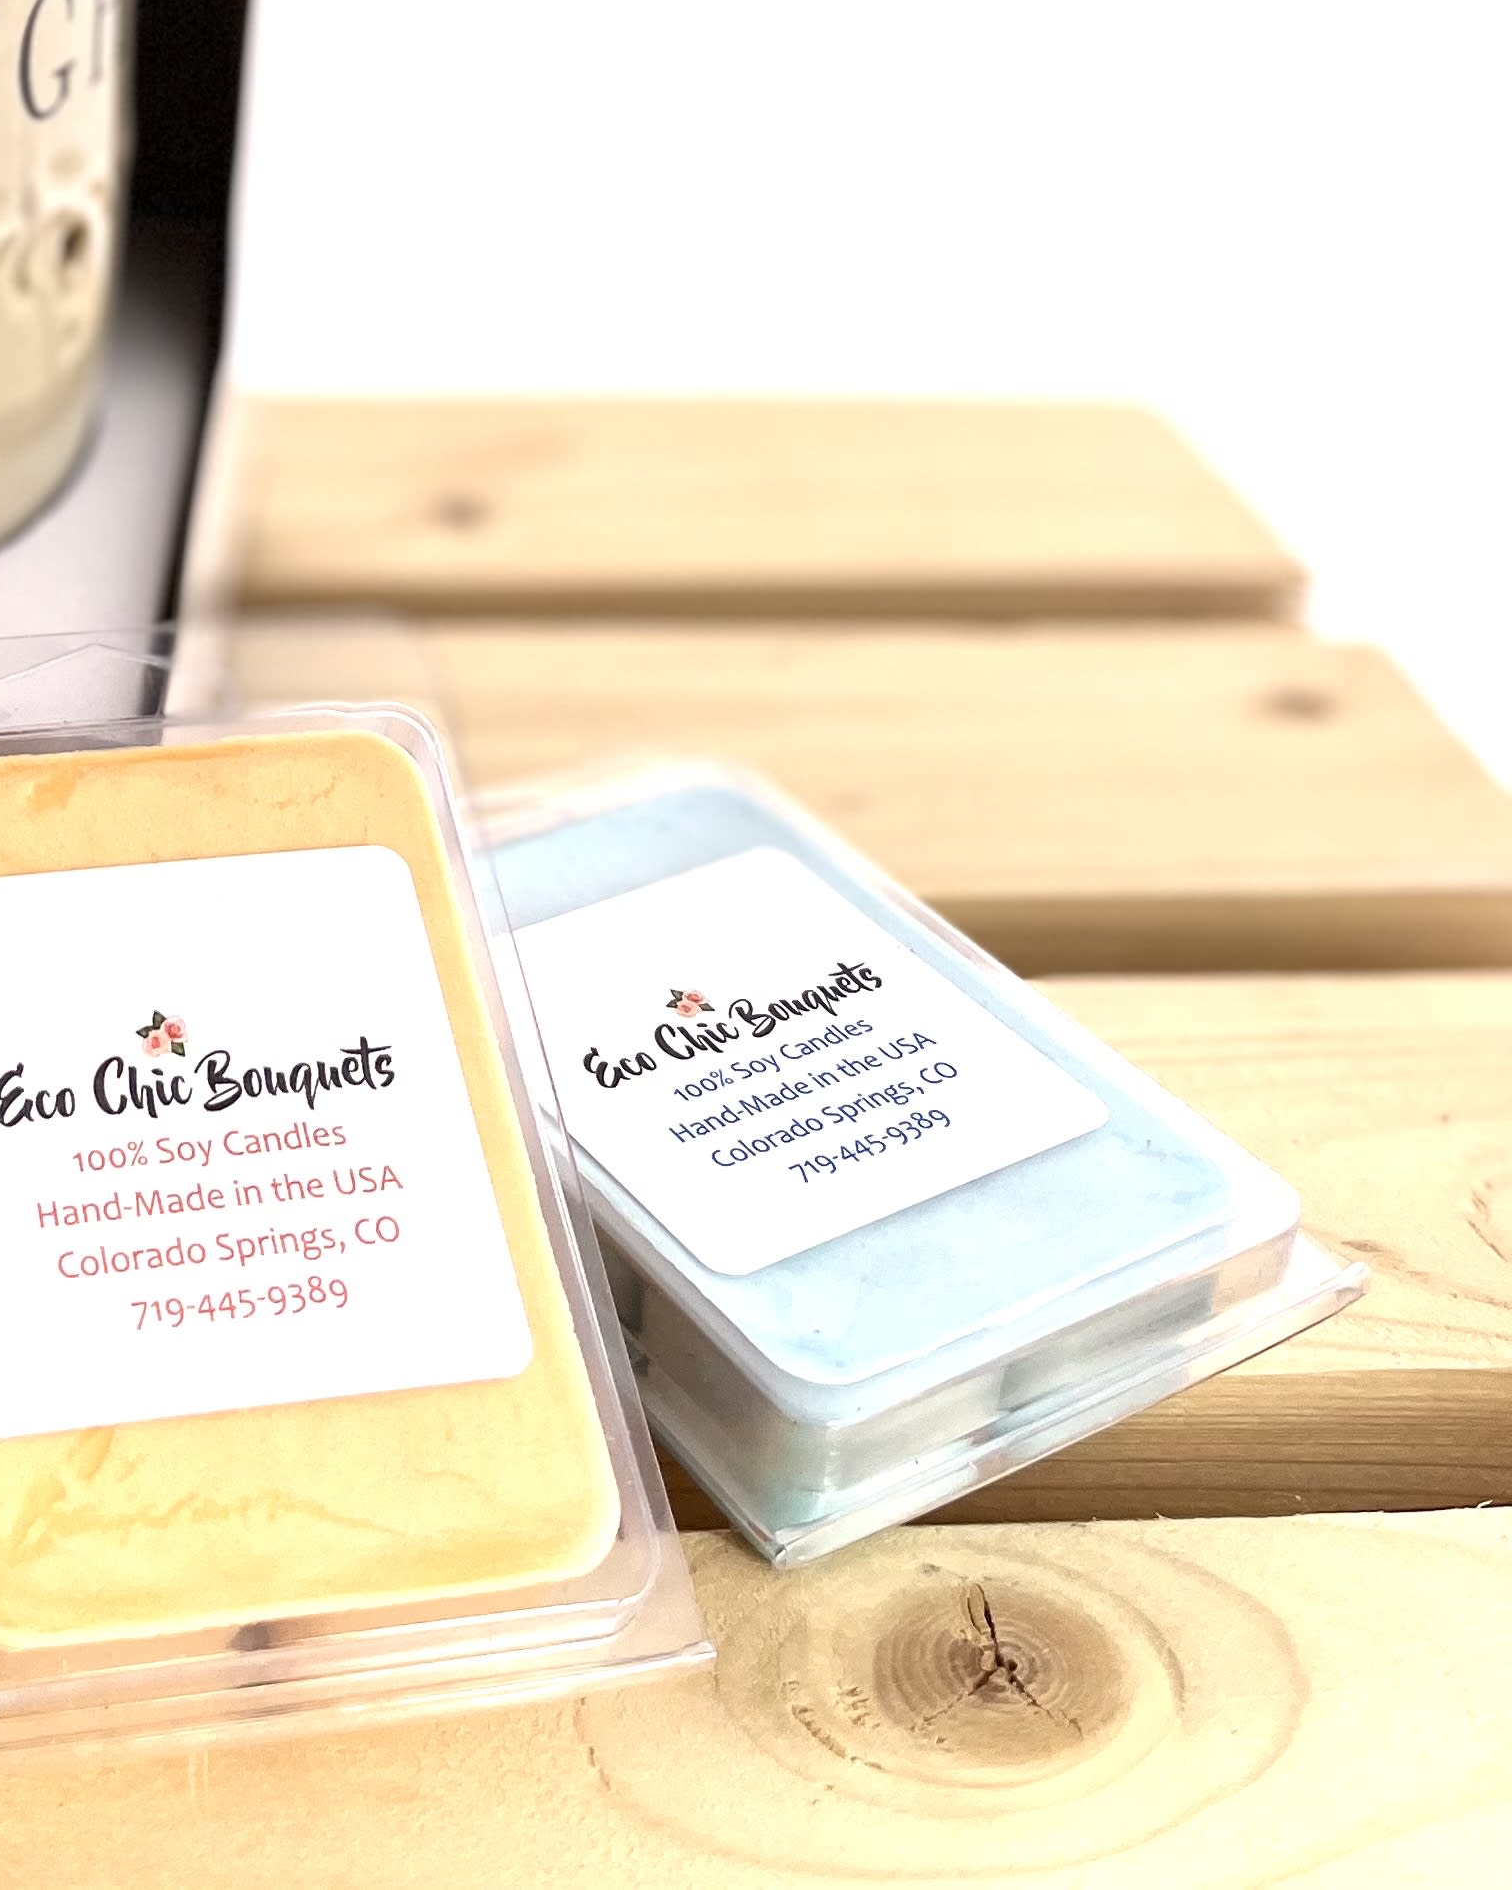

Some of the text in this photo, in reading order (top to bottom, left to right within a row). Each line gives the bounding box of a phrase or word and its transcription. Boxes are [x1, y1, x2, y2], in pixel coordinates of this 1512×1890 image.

[583, 962, 883, 1089] Eco Chic Bouquets
[673, 1018, 874, 1102] 100% Soy Candles
[93, 1057, 193, 1118] Chic
[194, 1036, 395, 1112] Bouquets
[669, 1031, 937, 1143] Hand-Made in the USA
[711, 1061, 958, 1168] Colorado Springs, CO
[72, 1121, 347, 1173] 100% Soy Candles
[788, 1109, 951, 1183] 719-445-9389
[37, 1164, 403, 1229] Hand-Made in the USA
[57, 1216, 400, 1279] Colorado Springs, CO
[131, 1276, 349, 1330] 719-445-9389
